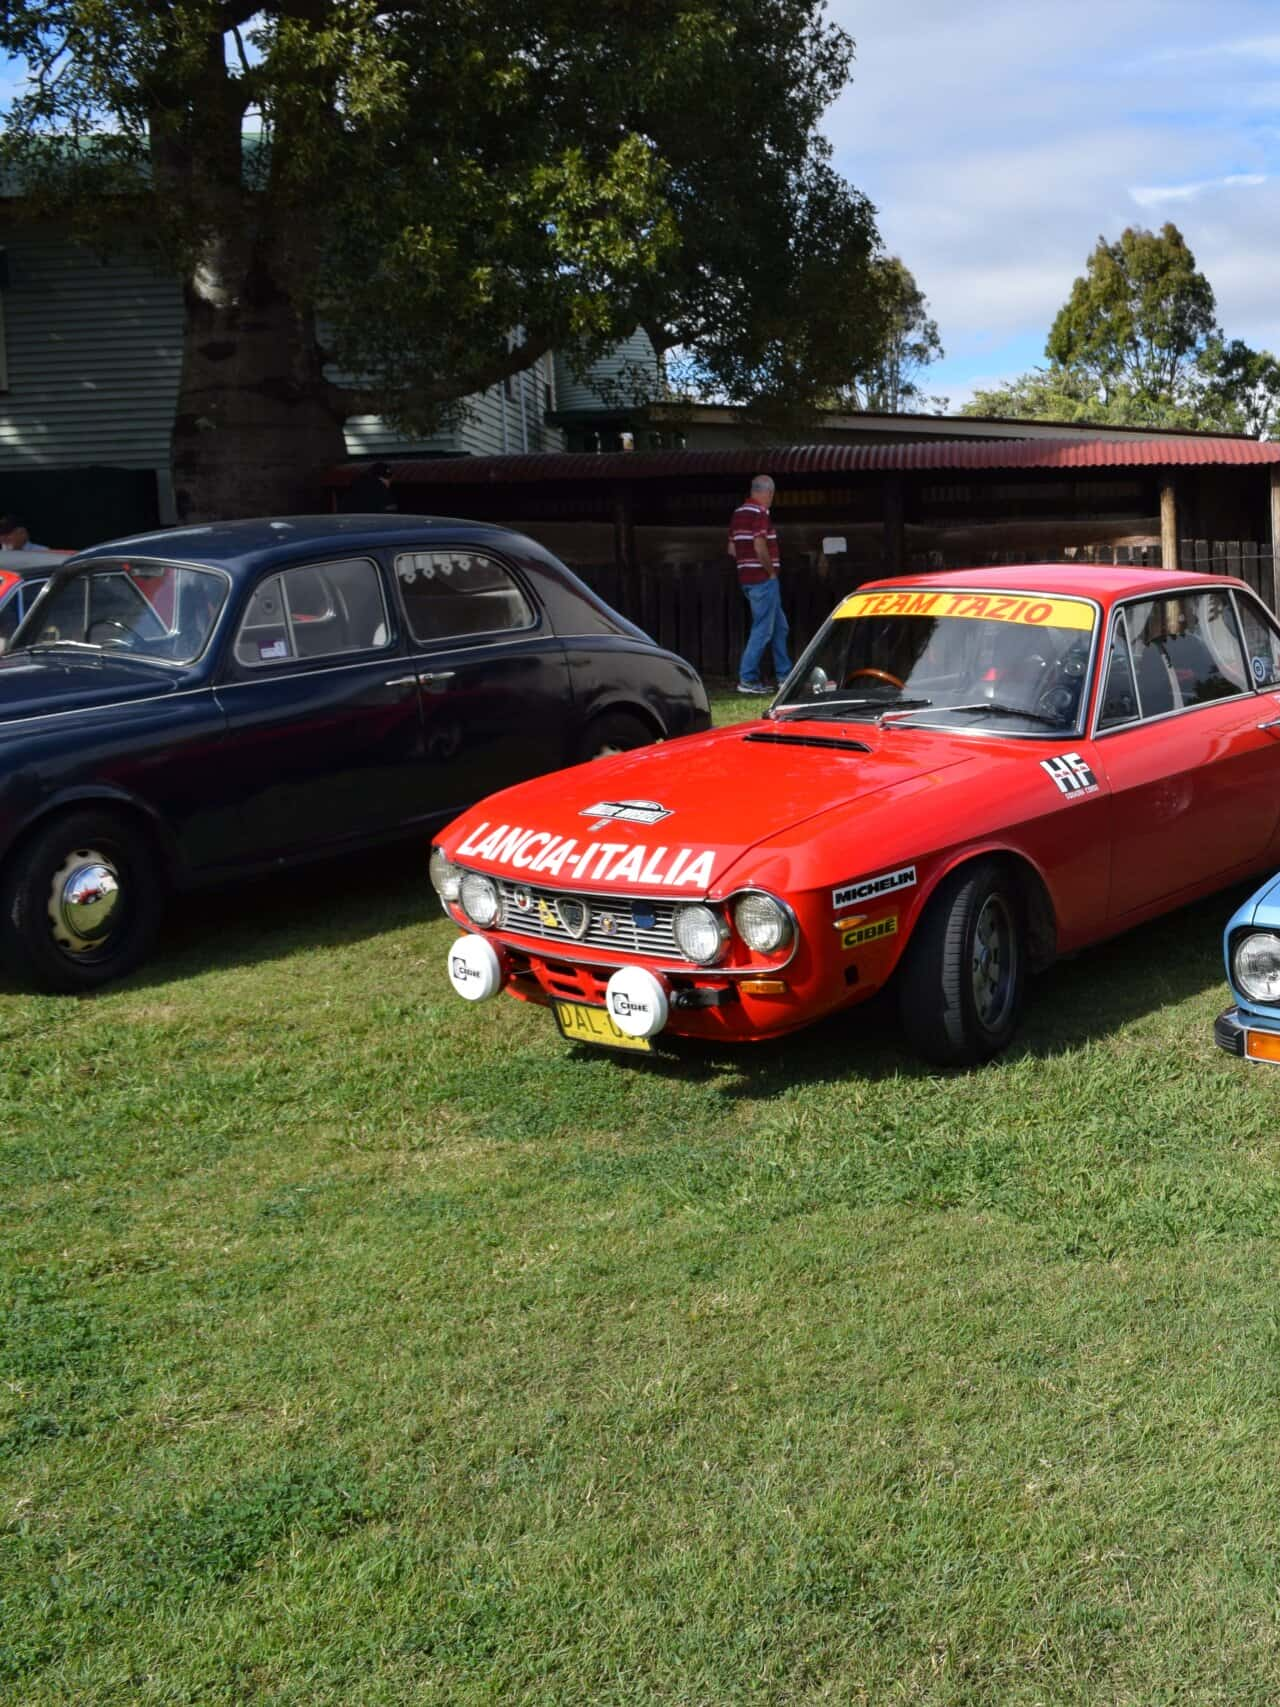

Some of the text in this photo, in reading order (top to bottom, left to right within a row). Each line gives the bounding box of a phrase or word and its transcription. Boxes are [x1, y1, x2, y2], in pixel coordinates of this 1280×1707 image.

[857, 594, 1054, 624] TEAM TAZIO
[1040, 752, 1092, 793] HF
[456, 822, 716, 888] LANCIA-ITALIA
[835, 871, 915, 905] MICHELIN
